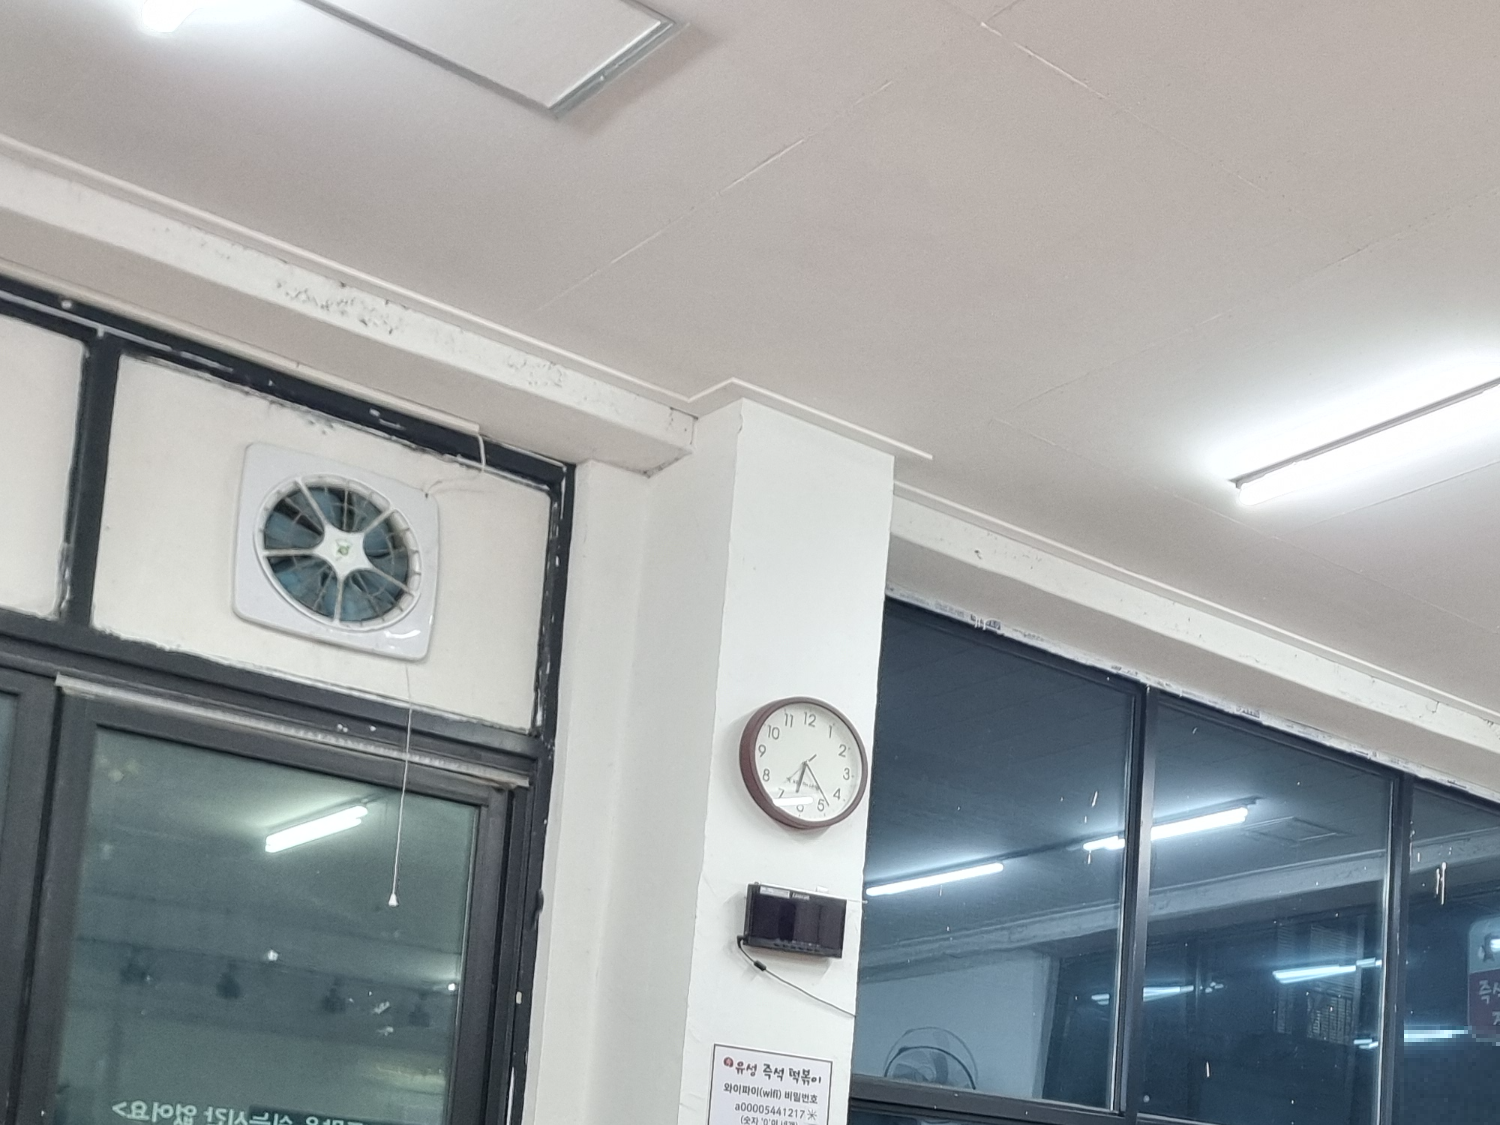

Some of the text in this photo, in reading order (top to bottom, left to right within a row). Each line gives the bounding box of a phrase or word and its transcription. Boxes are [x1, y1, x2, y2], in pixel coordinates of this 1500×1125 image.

[785, 713, 793, 728] 11
[804, 712, 816, 728] 12
[768, 725, 780, 739] 10
[829, 725, 833, 738] 1
[758, 744, 766, 757] 9
[838, 744, 846, 757] 2
[763, 769, 770, 782] 8
[843, 768, 850, 780] 3
[833, 788, 841, 800] 4
[817, 799, 825, 812] 5
[735, 1059, 822, 1086] 유성 즉석 떡볶이
[785, 1090, 818, 1104] 비밀번호
